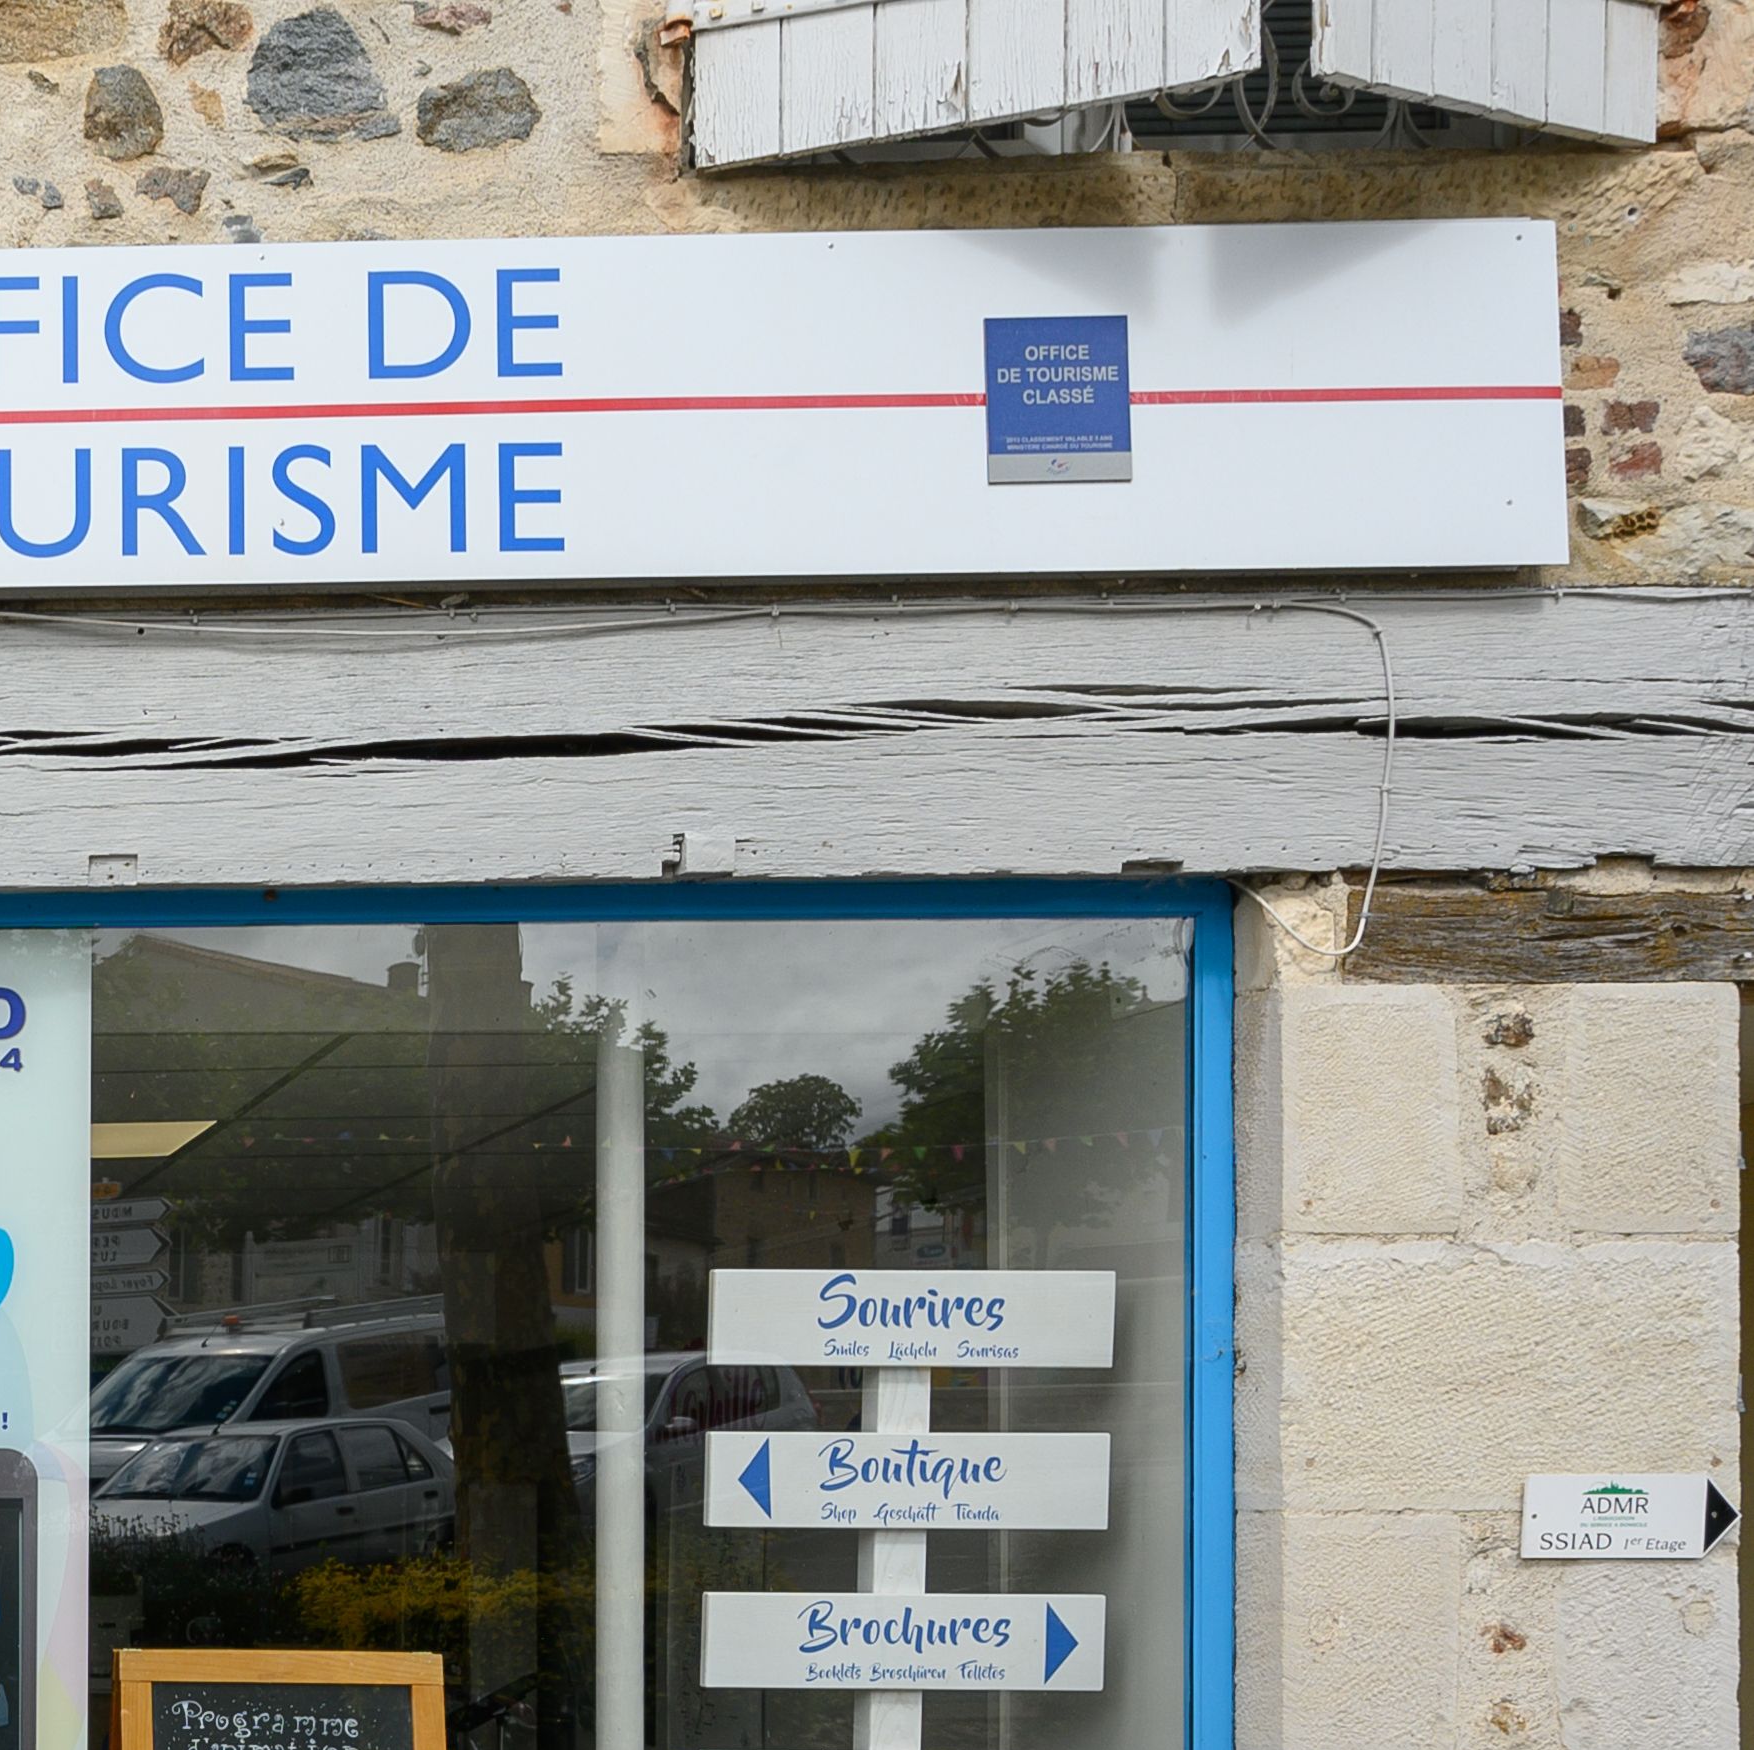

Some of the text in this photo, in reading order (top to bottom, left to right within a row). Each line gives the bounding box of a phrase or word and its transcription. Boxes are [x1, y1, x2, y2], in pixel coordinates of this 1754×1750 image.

[368, 267, 566, 381] DE
[1024, 345, 1090, 361] OFFICE
[997, 366, 1119, 384] DE TOURISME
[1023, 385, 1095, 405] CLASSÉ
[817, 1273, 1006, 1332] Sourires
[823, 1339, 1020, 1361] Smiles Lächeln Sonrisas
[818, 1438, 1007, 1499] Boutique
[820, 1501, 1001, 1525] Shop Geschäft Tienda
[1580, 1496, 1649, 1514] ADMR
[1539, 1532, 1612, 1551] SSIAD
[1645, 1537, 1687, 1553] Etage
[798, 1600, 1011, 1655] Brochures
[806, 1662, 862, 1682] Booklets
[869, 1662, 946, 1683] Broschüren
[171, 1700, 360, 1738] Programme
